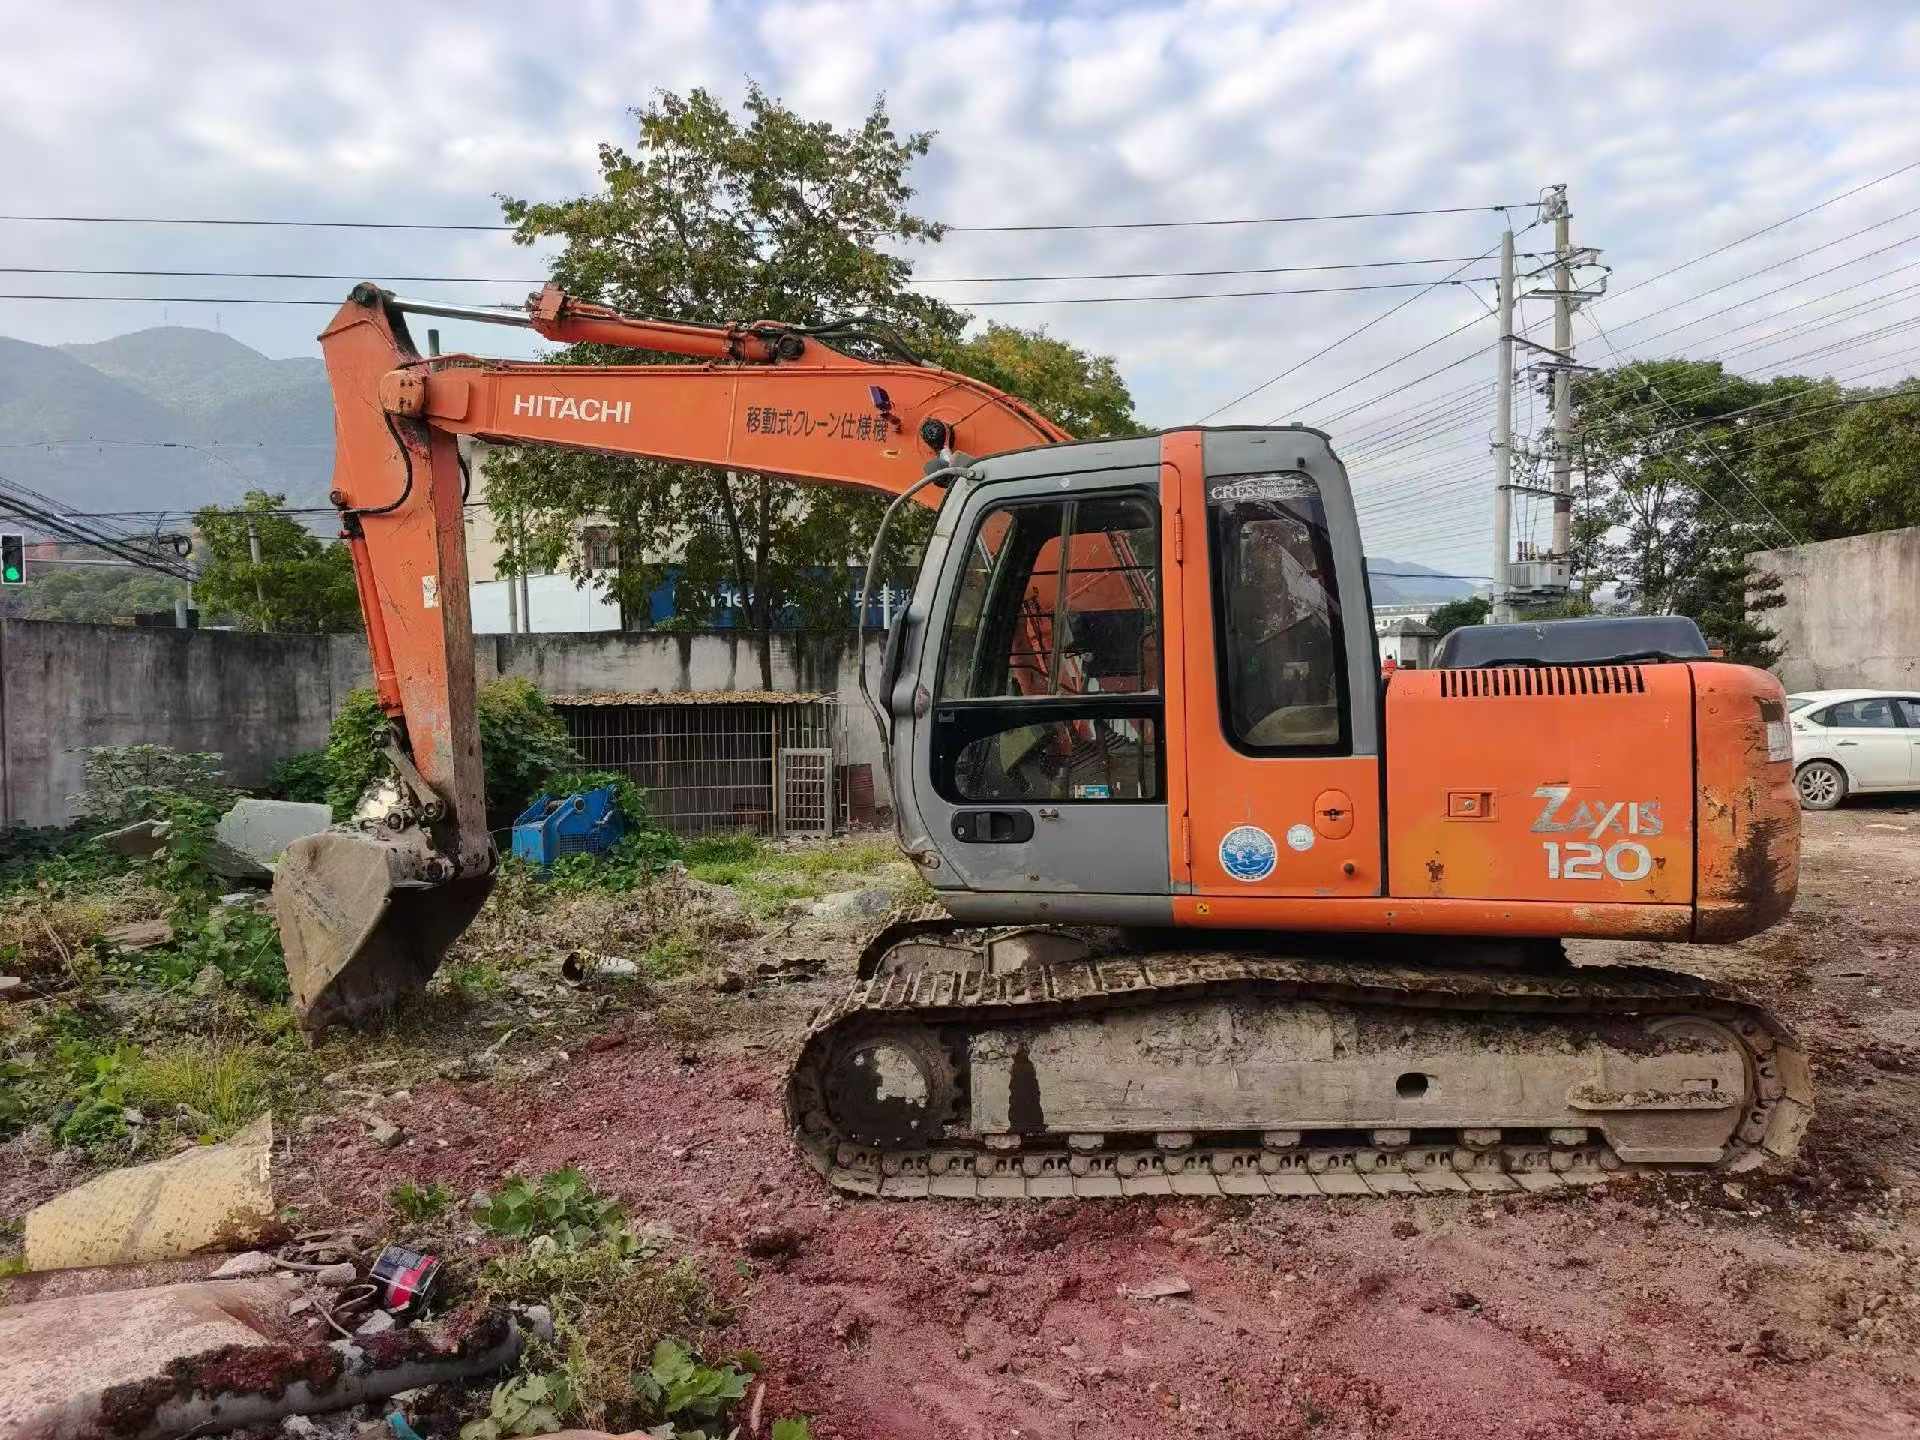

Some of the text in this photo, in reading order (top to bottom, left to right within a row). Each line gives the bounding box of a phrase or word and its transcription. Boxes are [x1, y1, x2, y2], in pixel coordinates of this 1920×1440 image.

[513, 394, 632, 424] HITACHI
[1529, 786, 1664, 840] ZAXIS
[1543, 840, 1653, 881] 120
